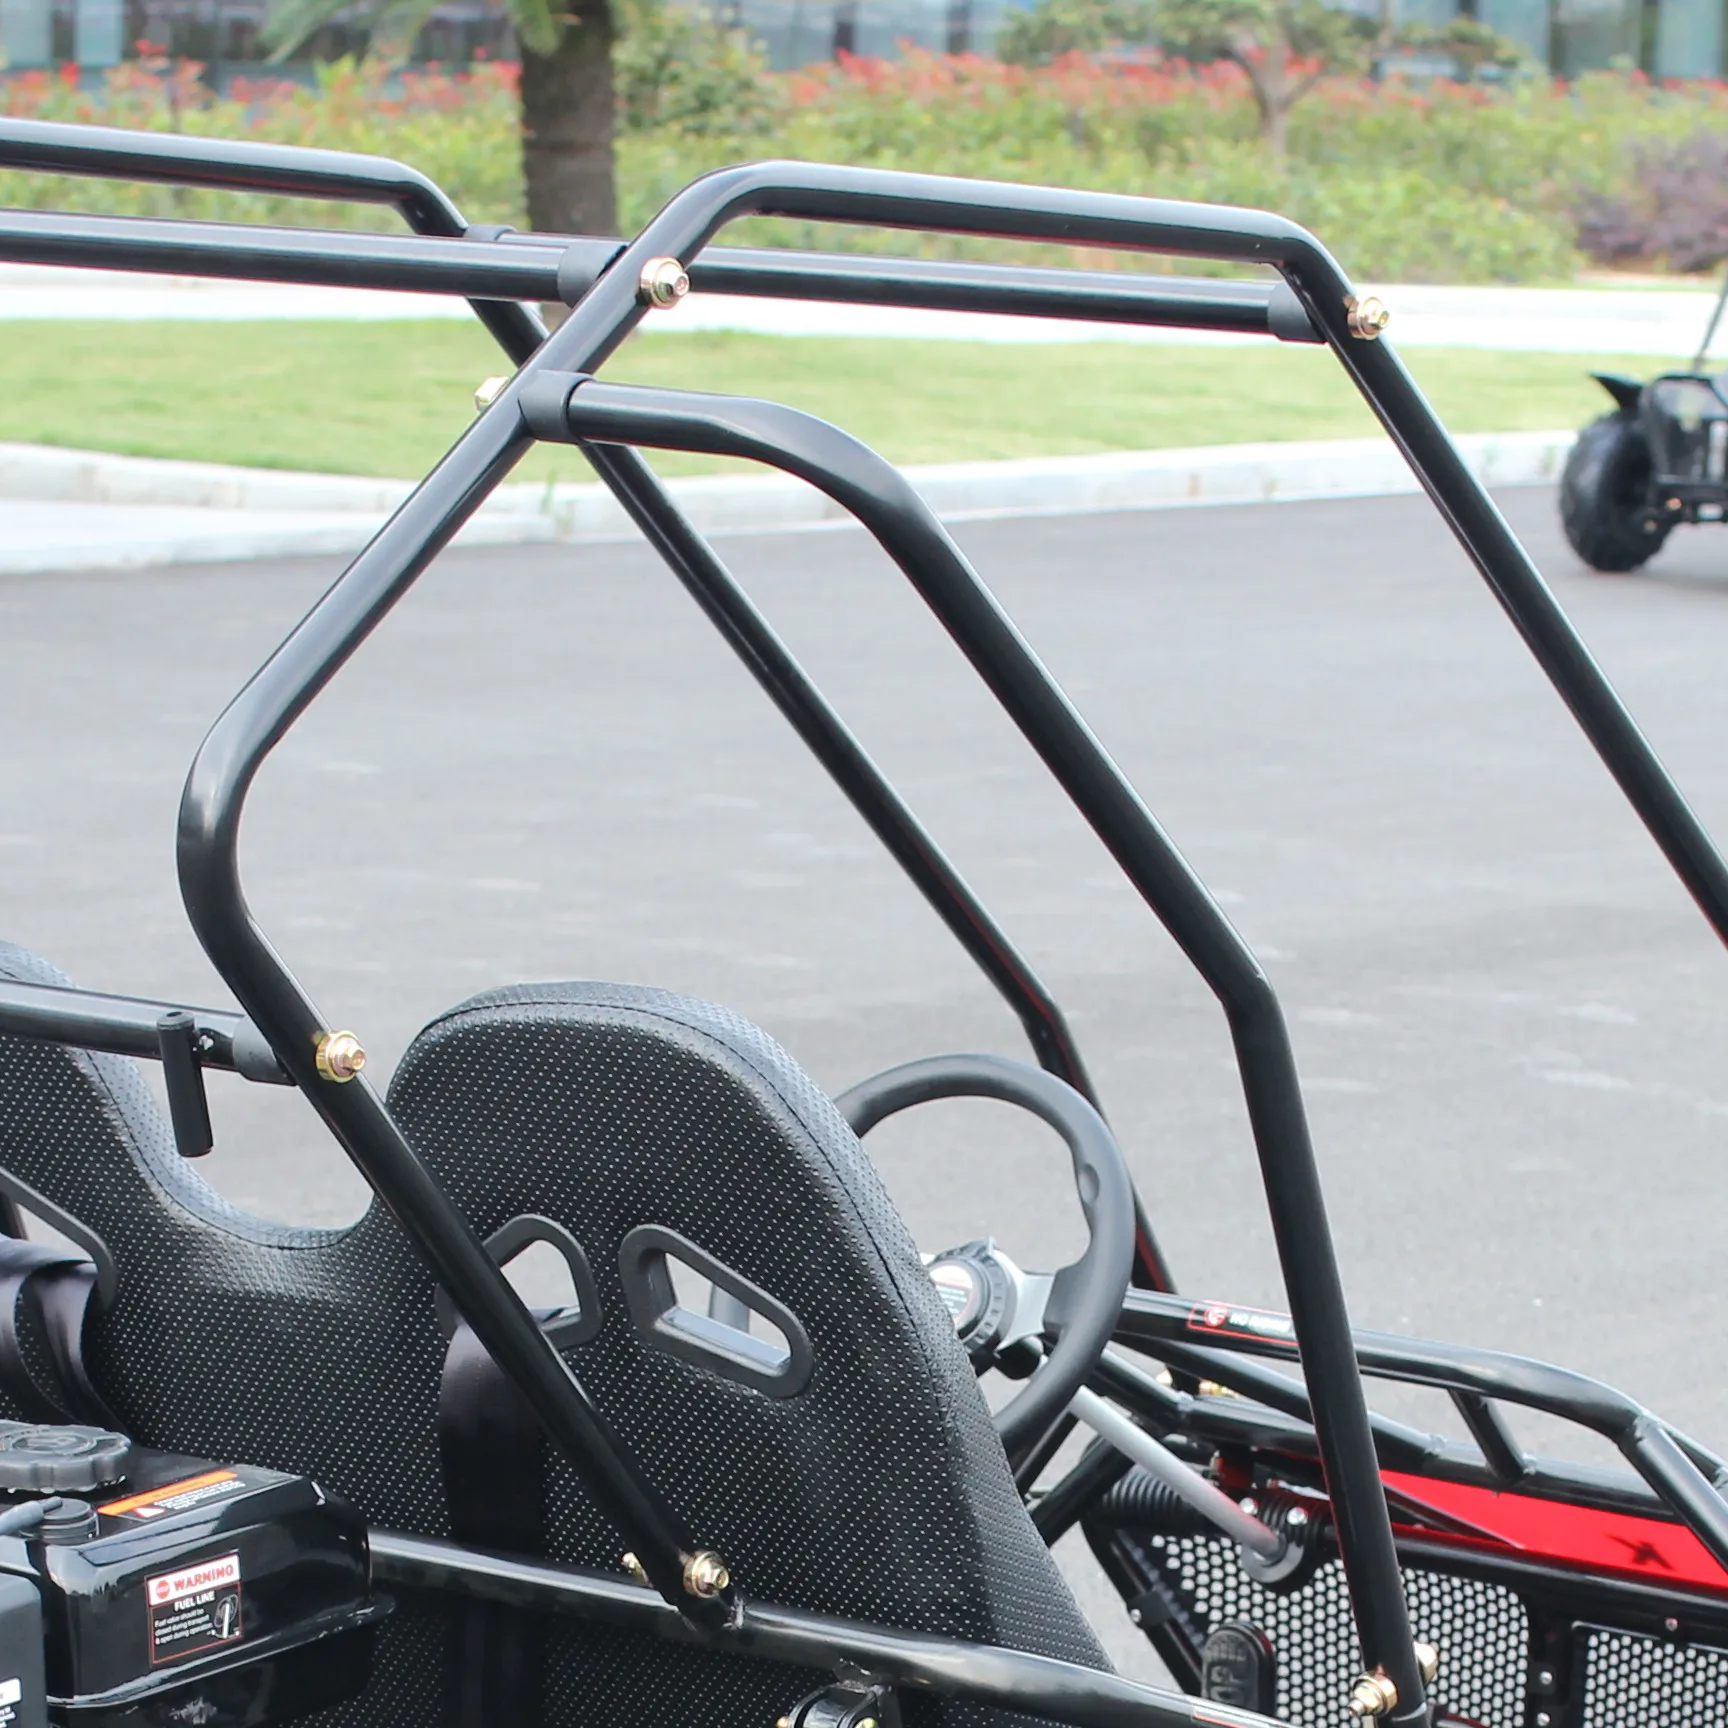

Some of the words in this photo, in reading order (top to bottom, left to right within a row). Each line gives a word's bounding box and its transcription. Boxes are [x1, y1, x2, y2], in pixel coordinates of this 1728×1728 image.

[174, 1564, 234, 1592] WARNING
[174, 1598, 195, 1613] FUEL
[196, 1591, 216, 1607] LINE
